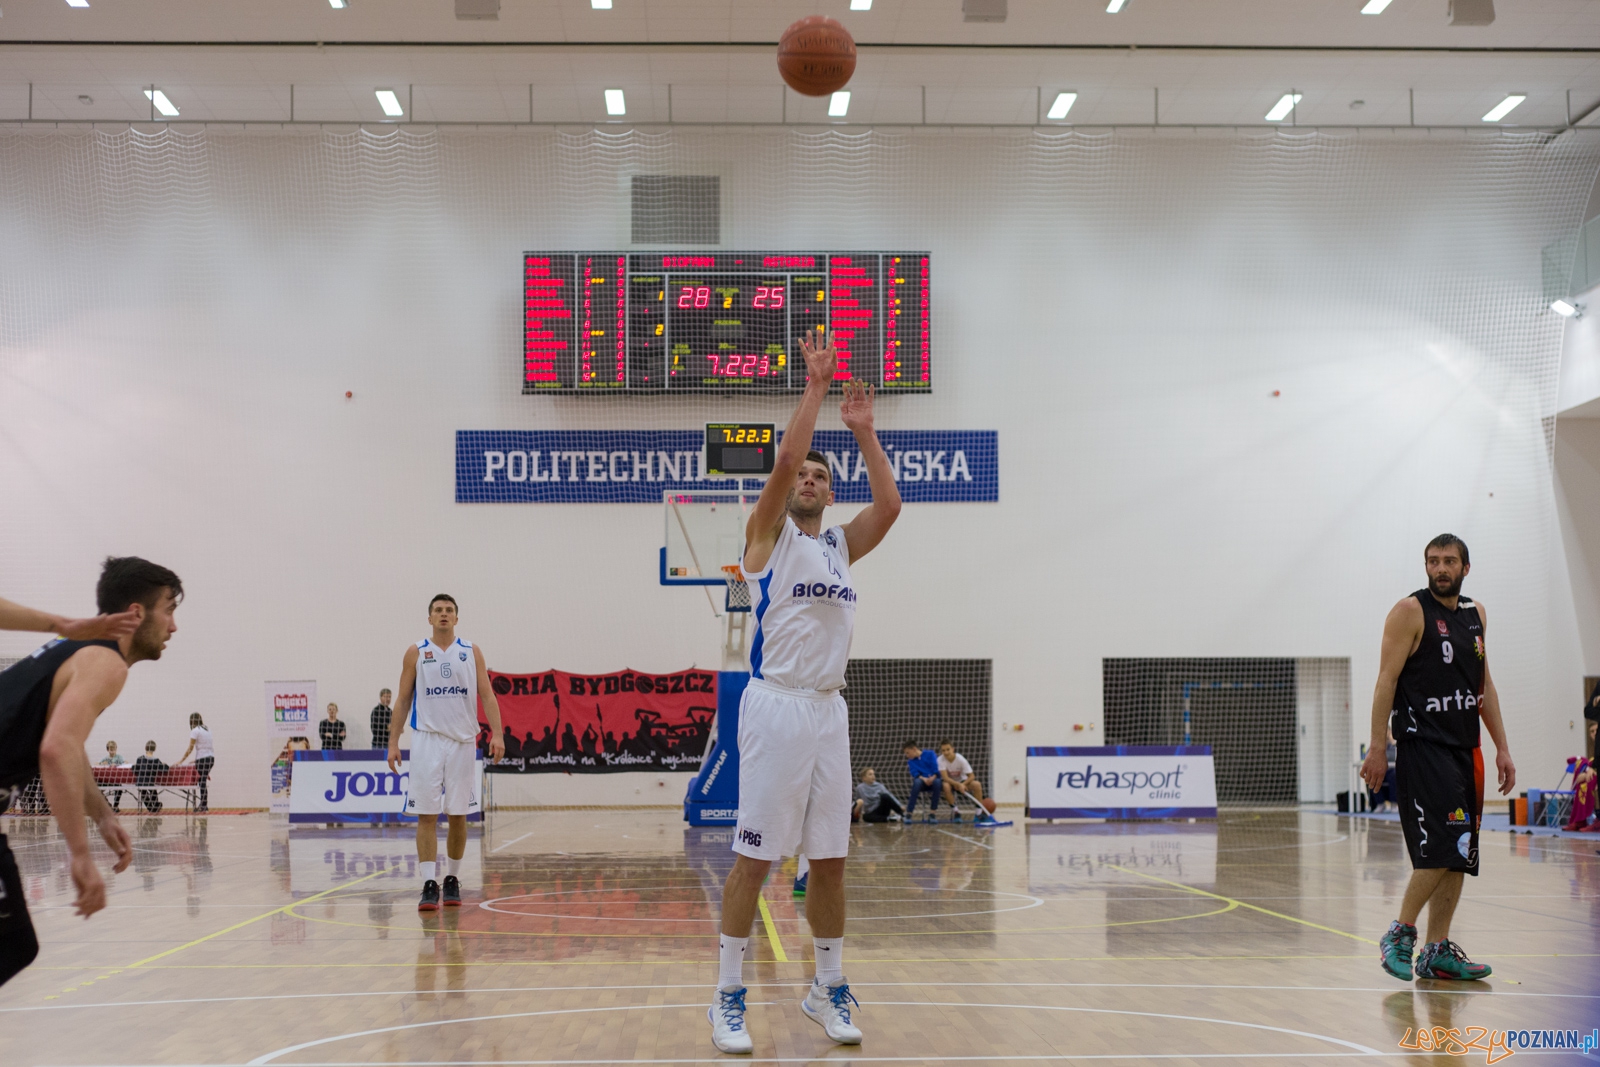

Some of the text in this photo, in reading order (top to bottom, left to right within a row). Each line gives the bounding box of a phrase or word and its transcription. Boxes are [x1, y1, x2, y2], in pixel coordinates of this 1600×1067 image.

[663, 257, 714, 267] BIOFARM
[763, 257, 815, 267] ASTORIA
[658, 290, 664, 301] 1
[677, 286, 711, 309] 28
[723, 297, 733, 309] 2
[752, 286, 785, 309] 25
[816, 290, 825, 301] 3
[655, 324, 664, 335] 2
[777, 354, 786, 366] 5
[722, 429, 771, 443] 7.22.3
[484, 444, 973, 482] POLITECHNI NAŃSKA
[1441, 641, 1454, 664] 9
[440, 662, 452, 679] 6
[487, 673, 714, 696] ORIA BYDGOSZCZ
[581, 756, 596, 766] na
[701, 750, 728, 795] HYDROPLAY
[1056, 764, 1184, 794] rehasport
[324, 772, 410, 803] Jom
[1149, 790, 1182, 800] clinic
[743, 829, 762, 847] PBG
